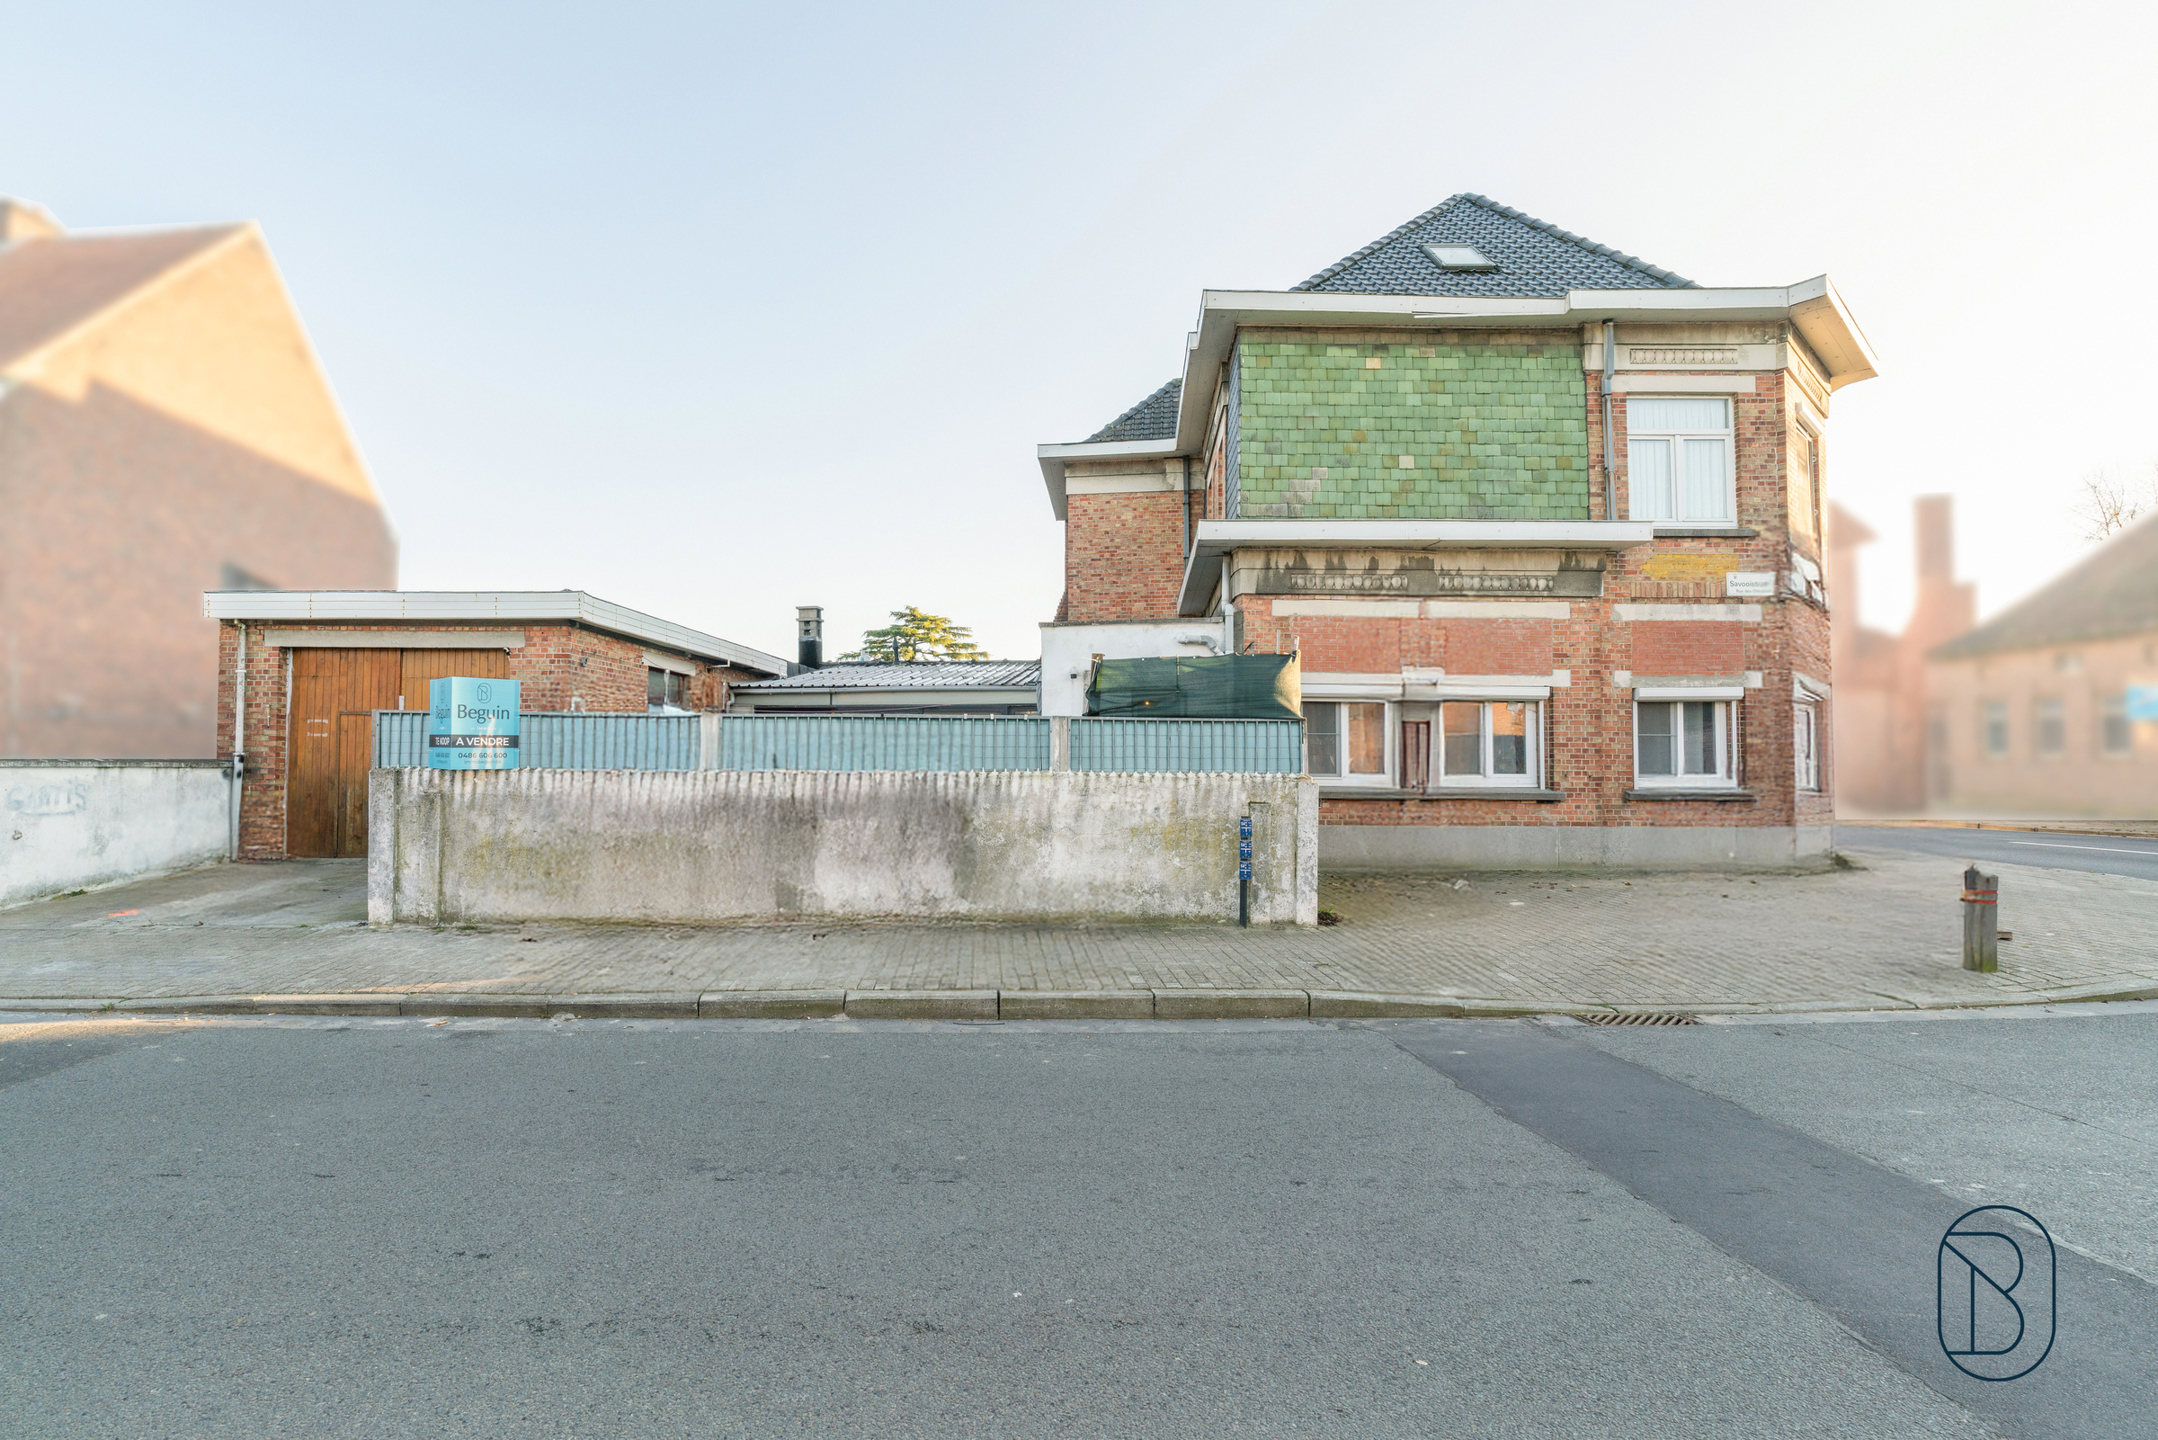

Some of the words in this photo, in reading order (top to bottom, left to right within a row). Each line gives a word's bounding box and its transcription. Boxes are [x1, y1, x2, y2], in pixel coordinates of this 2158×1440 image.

[457, 704, 509, 724] Beguin
[435, 737, 440, 746] TE
[440, 737, 450, 746] KOOP
[456, 737, 464, 746] A
[466, 737, 510, 746] VENDRE
